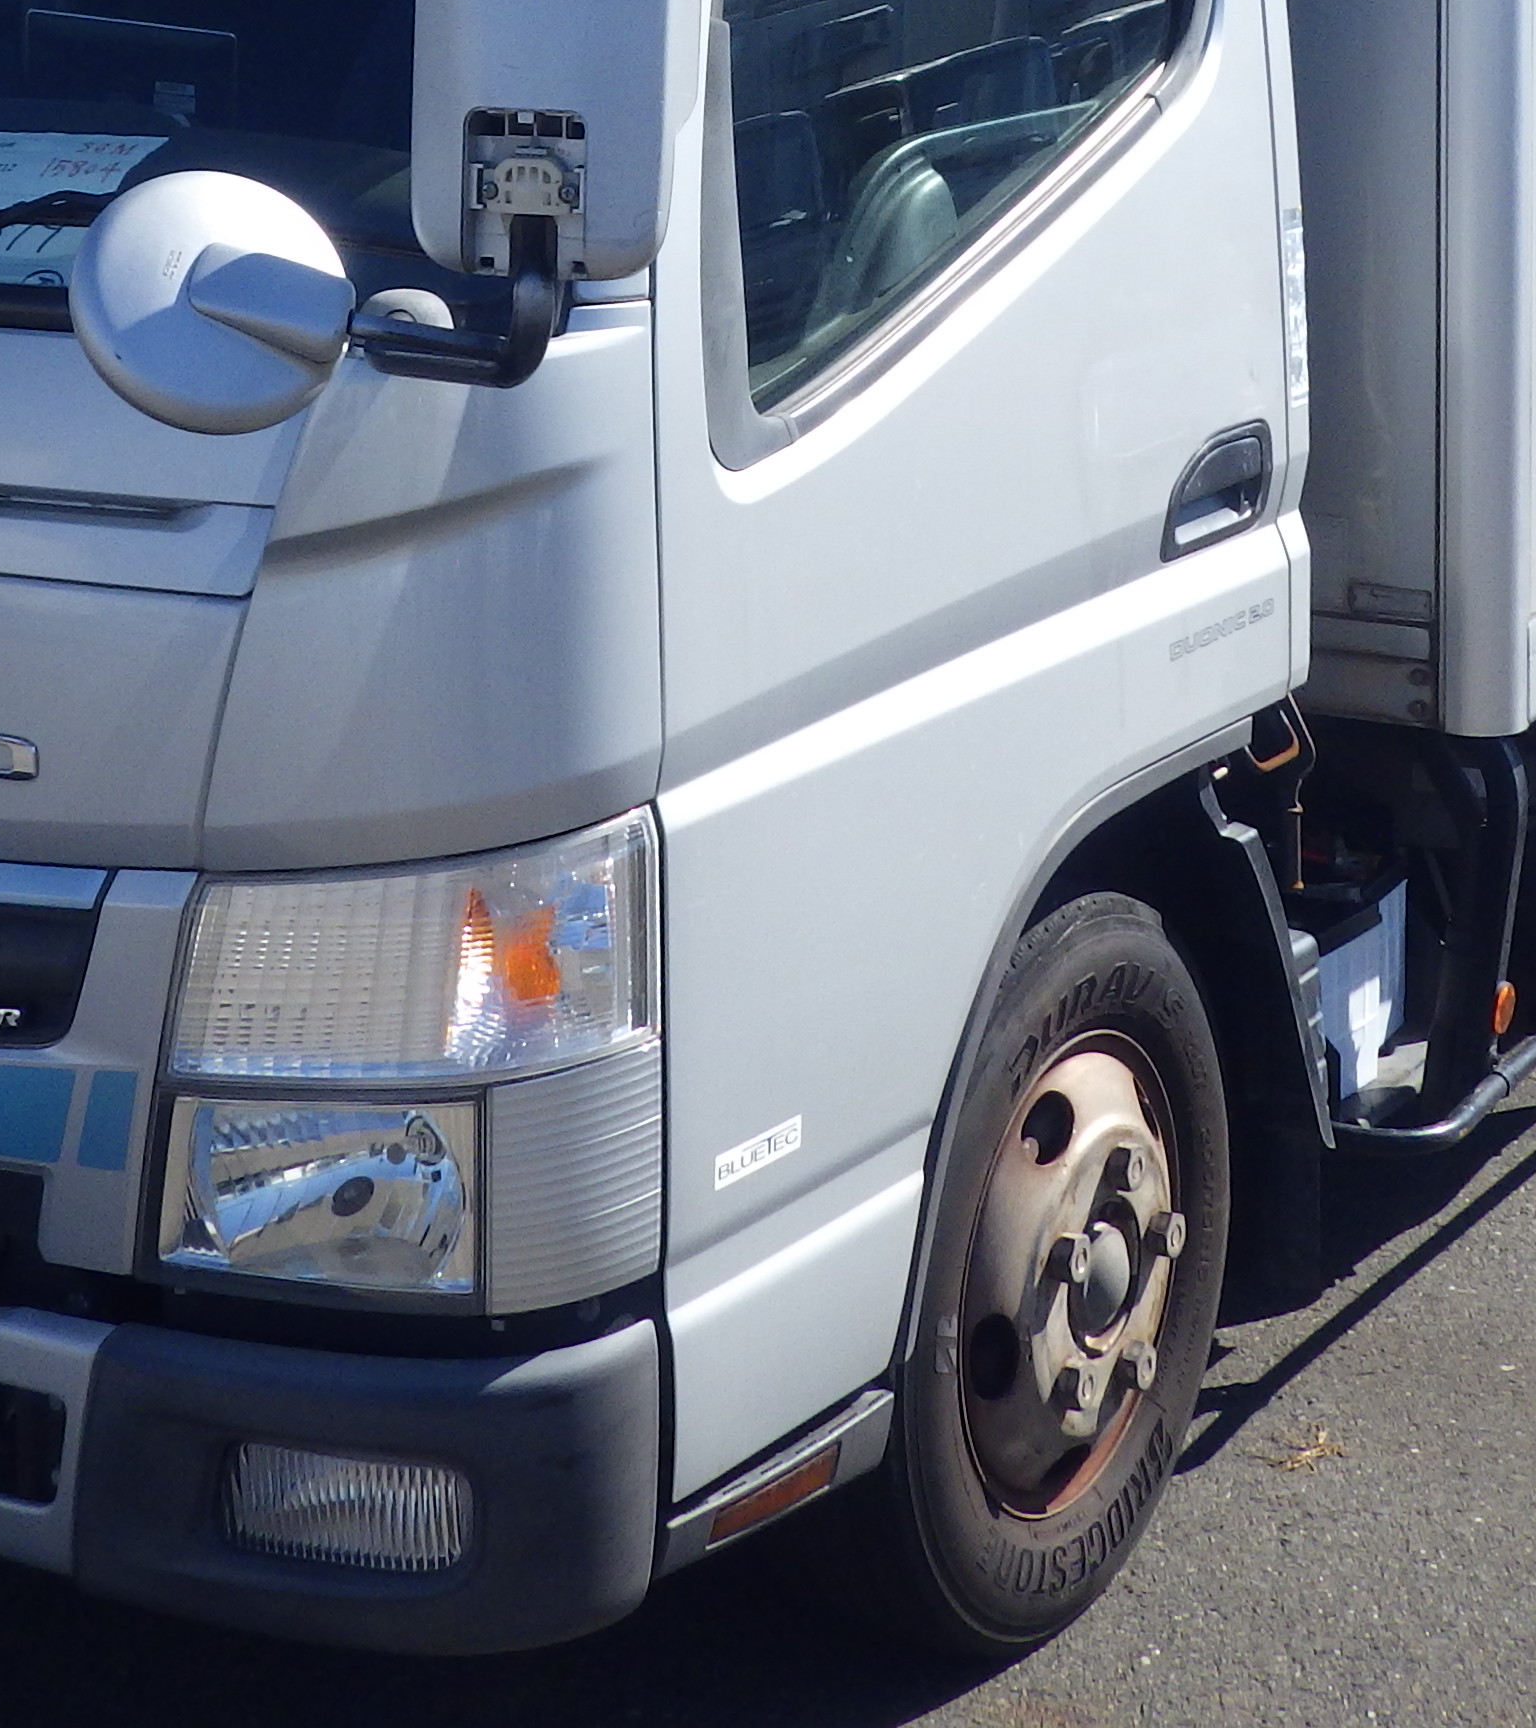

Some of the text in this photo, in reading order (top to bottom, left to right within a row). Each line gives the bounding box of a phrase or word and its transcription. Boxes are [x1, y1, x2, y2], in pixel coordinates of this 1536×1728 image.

[1168, 609, 1247, 663] DUONIC
[718, 1122, 799, 1182] BLUETEC
[975, 1417, 1175, 1601] BRIDGESTONE
